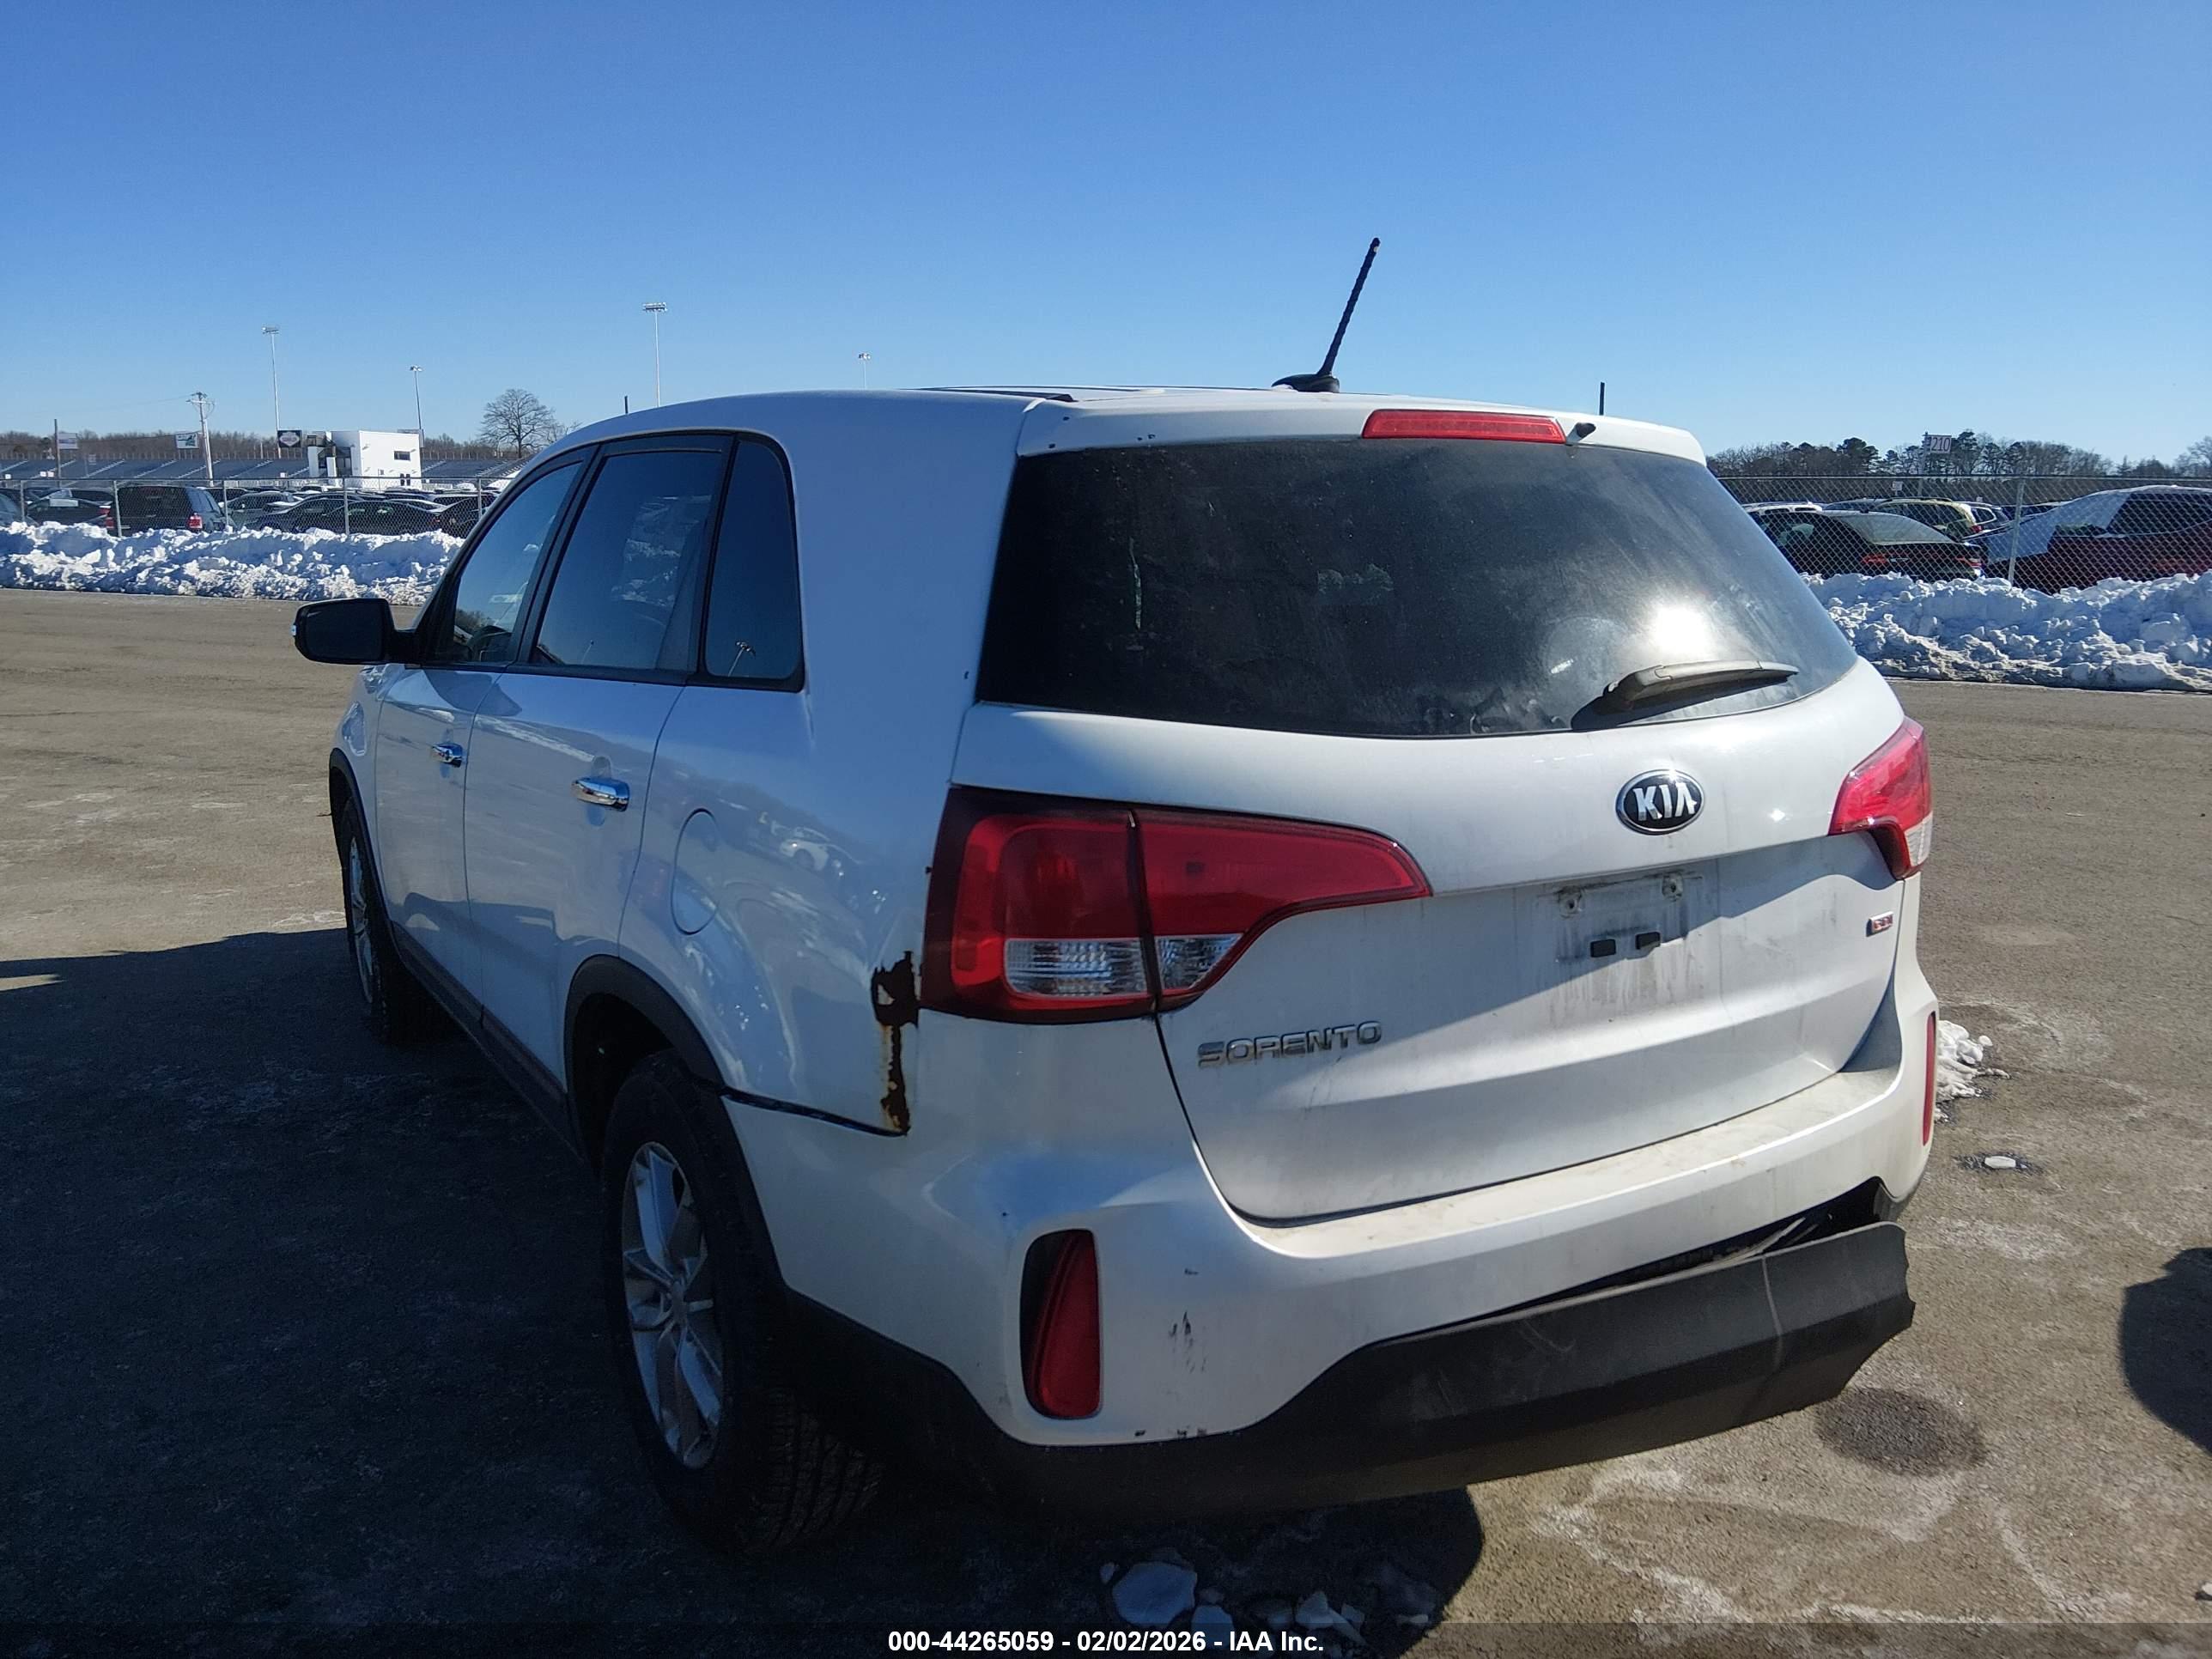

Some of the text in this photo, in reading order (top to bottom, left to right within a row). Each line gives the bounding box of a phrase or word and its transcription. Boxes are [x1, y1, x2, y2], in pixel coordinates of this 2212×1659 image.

[1931, 437, 1951, 452] 210
[1632, 782, 1698, 821] KIA
[1198, 1020, 1382, 1068] SORENTO
